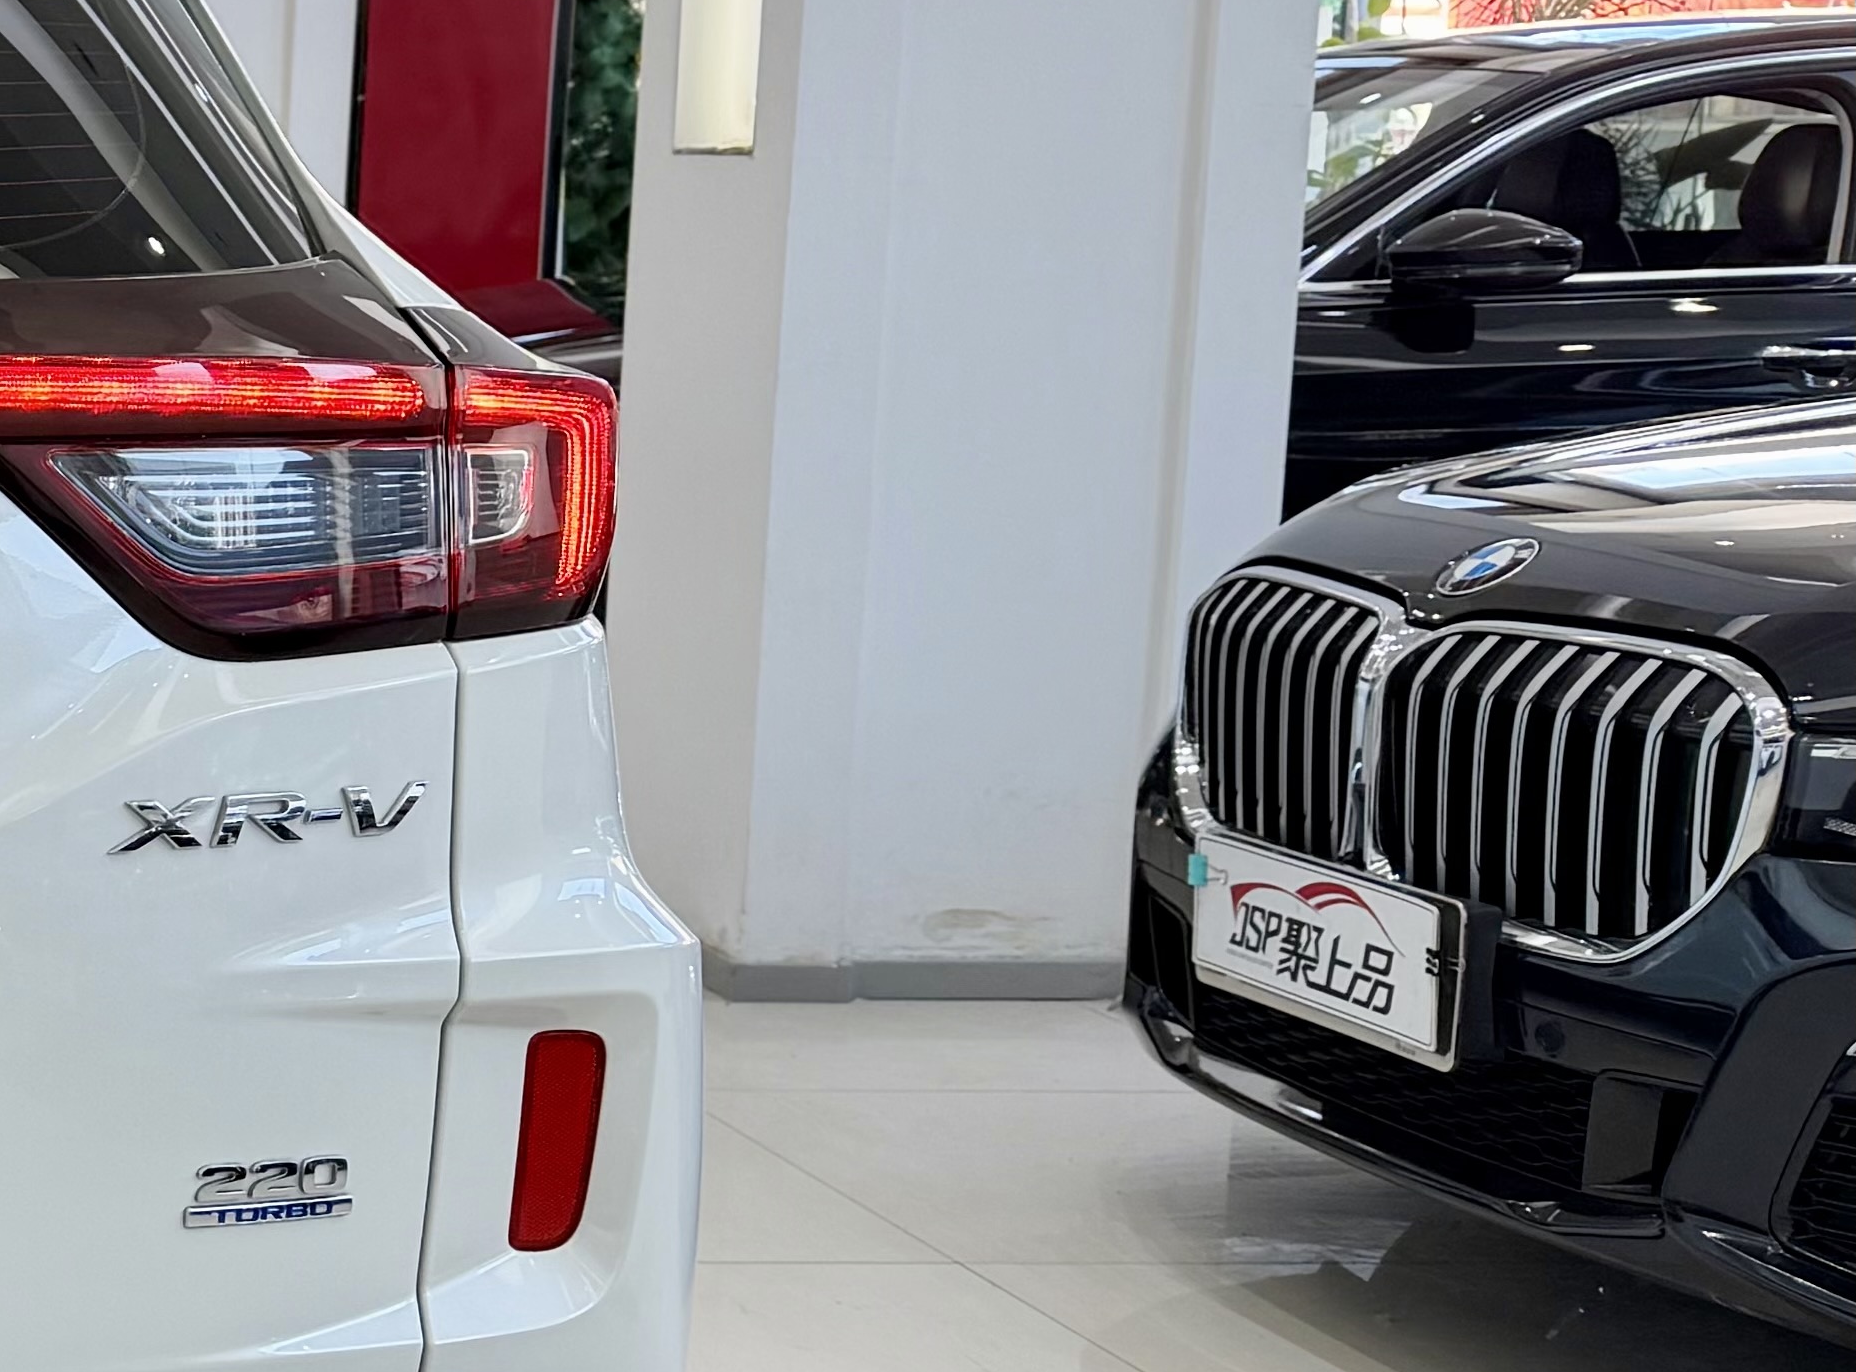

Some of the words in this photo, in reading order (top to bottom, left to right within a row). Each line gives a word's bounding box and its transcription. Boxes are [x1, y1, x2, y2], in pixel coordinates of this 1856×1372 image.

[108, 780, 429, 855] XR-V
[194, 1154, 350, 1203] 220
[214, 1201, 334, 1225] TURBO
